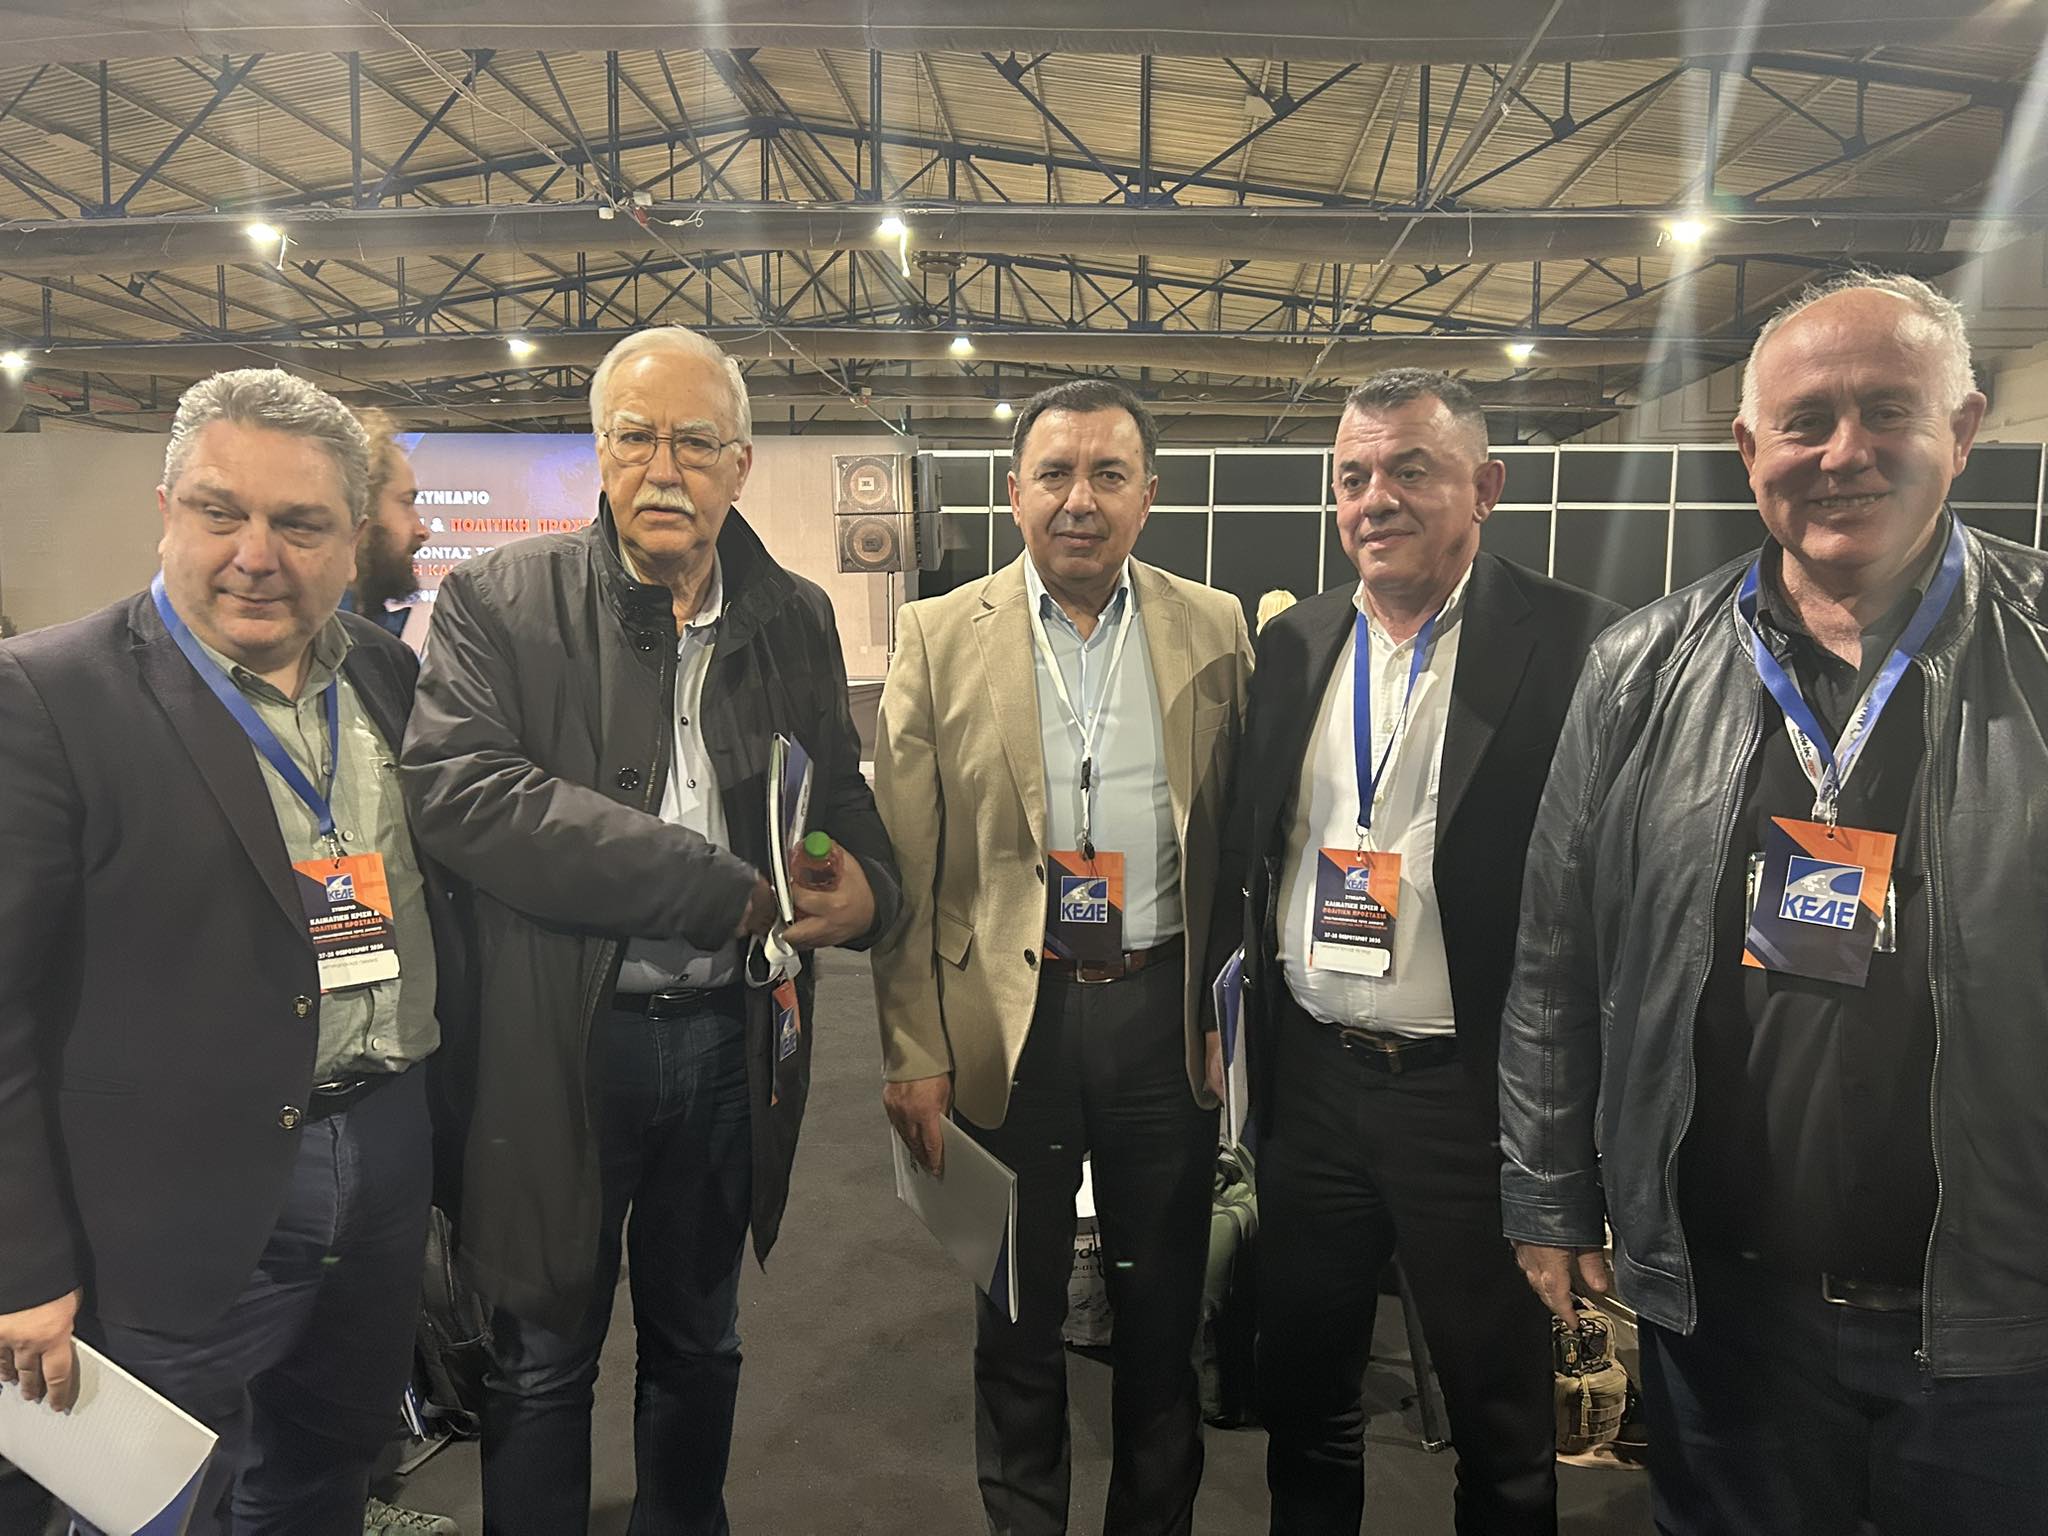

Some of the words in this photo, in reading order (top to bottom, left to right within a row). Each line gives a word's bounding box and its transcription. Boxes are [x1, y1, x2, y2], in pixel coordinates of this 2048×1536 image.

[430, 517, 446, 533] &
[451, 518, 530, 533] ΠΟΛΙΤΙΚΗ
[413, 546, 472, 560] ΟΝΤΑΣ
[1062, 902, 1107, 922] ΚΕΔΕ
[1781, 892, 1855, 927] ΚΕΔΕ
